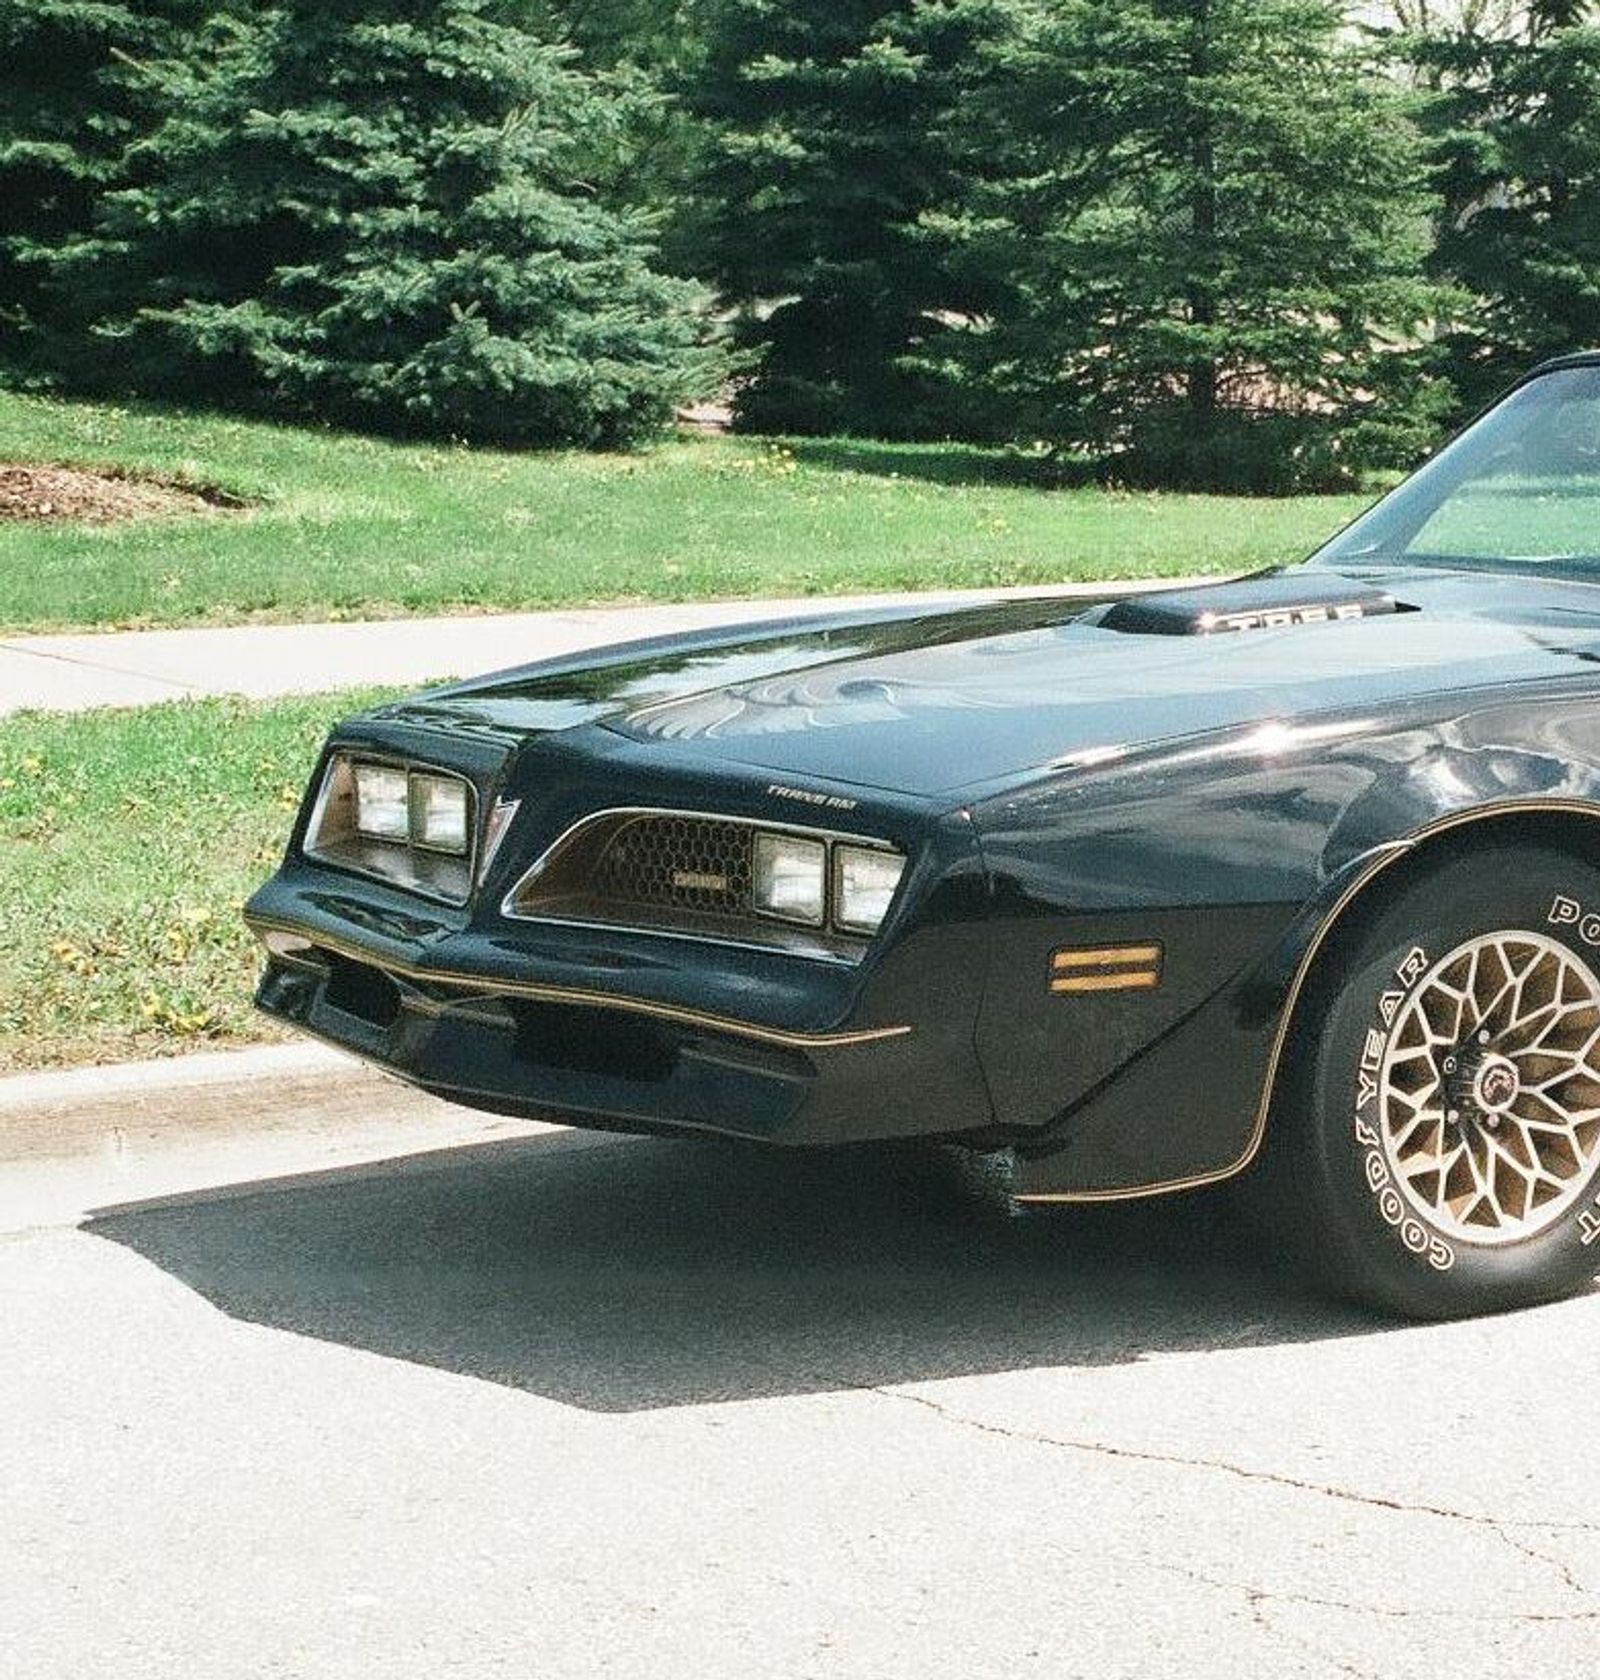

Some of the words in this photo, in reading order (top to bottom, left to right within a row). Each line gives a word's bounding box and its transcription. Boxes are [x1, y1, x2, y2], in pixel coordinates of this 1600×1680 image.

[768, 784, 828, 805] TRANS
[826, 796, 858, 810] AM
[1355, 947, 1455, 1271] GOODYEAR
